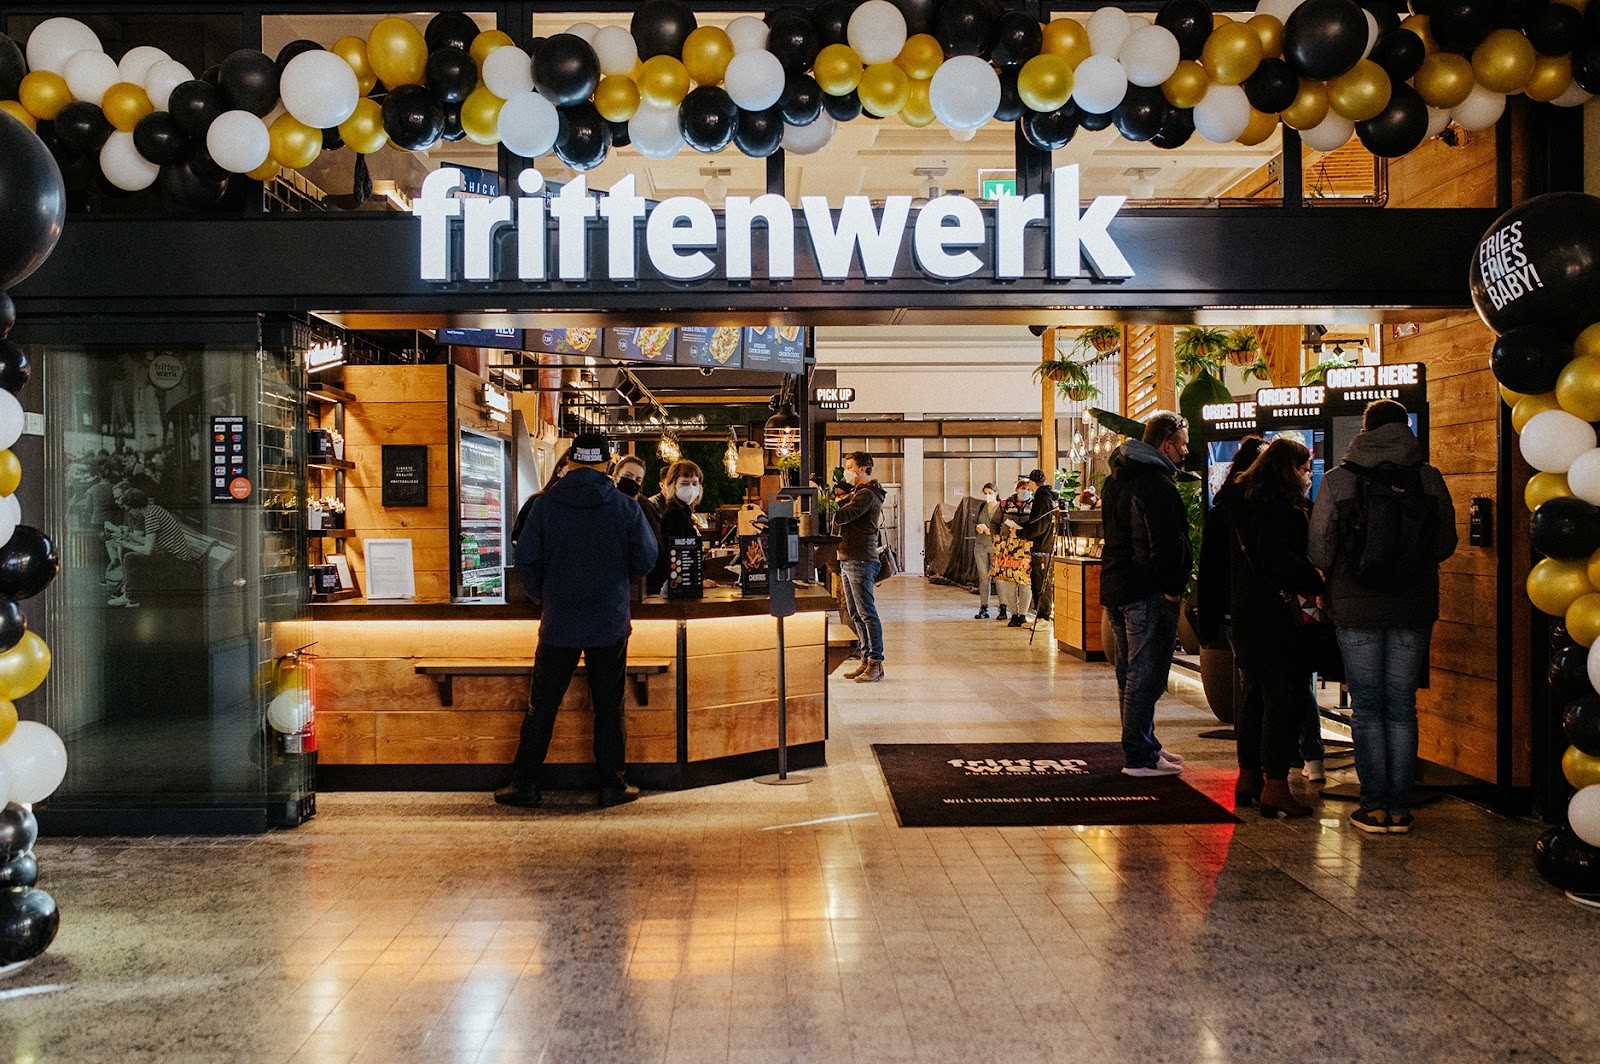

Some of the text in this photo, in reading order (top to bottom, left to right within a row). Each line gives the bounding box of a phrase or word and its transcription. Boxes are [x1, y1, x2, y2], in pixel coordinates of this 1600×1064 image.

[412, 164, 1136, 282] frittenwerk
[1480, 220, 1522, 264] FRIES
[1480, 242, 1528, 288] FRIES
[1486, 263, 1544, 311] BABY!
[1326, 364, 1418, 388] ORDER HERE
[816, 388, 853, 401] PICK UP
[1258, 388, 1299, 405] ORDER
[1343, 390, 1399, 401] BESTELLEN
[1202, 403, 1238, 420] ORDER
[1272, 407, 1320, 417] BESTELLEN
[1215, 420, 1257, 430] BESTELLEN
[576, 446, 591, 455] THANK
[748, 573, 767, 582] CHURROS
[947, 758, 1089, 768] fritten
[964, 765, 1082, 773] werk
[943, 796, 1033, 804] WILLKOMMEN
